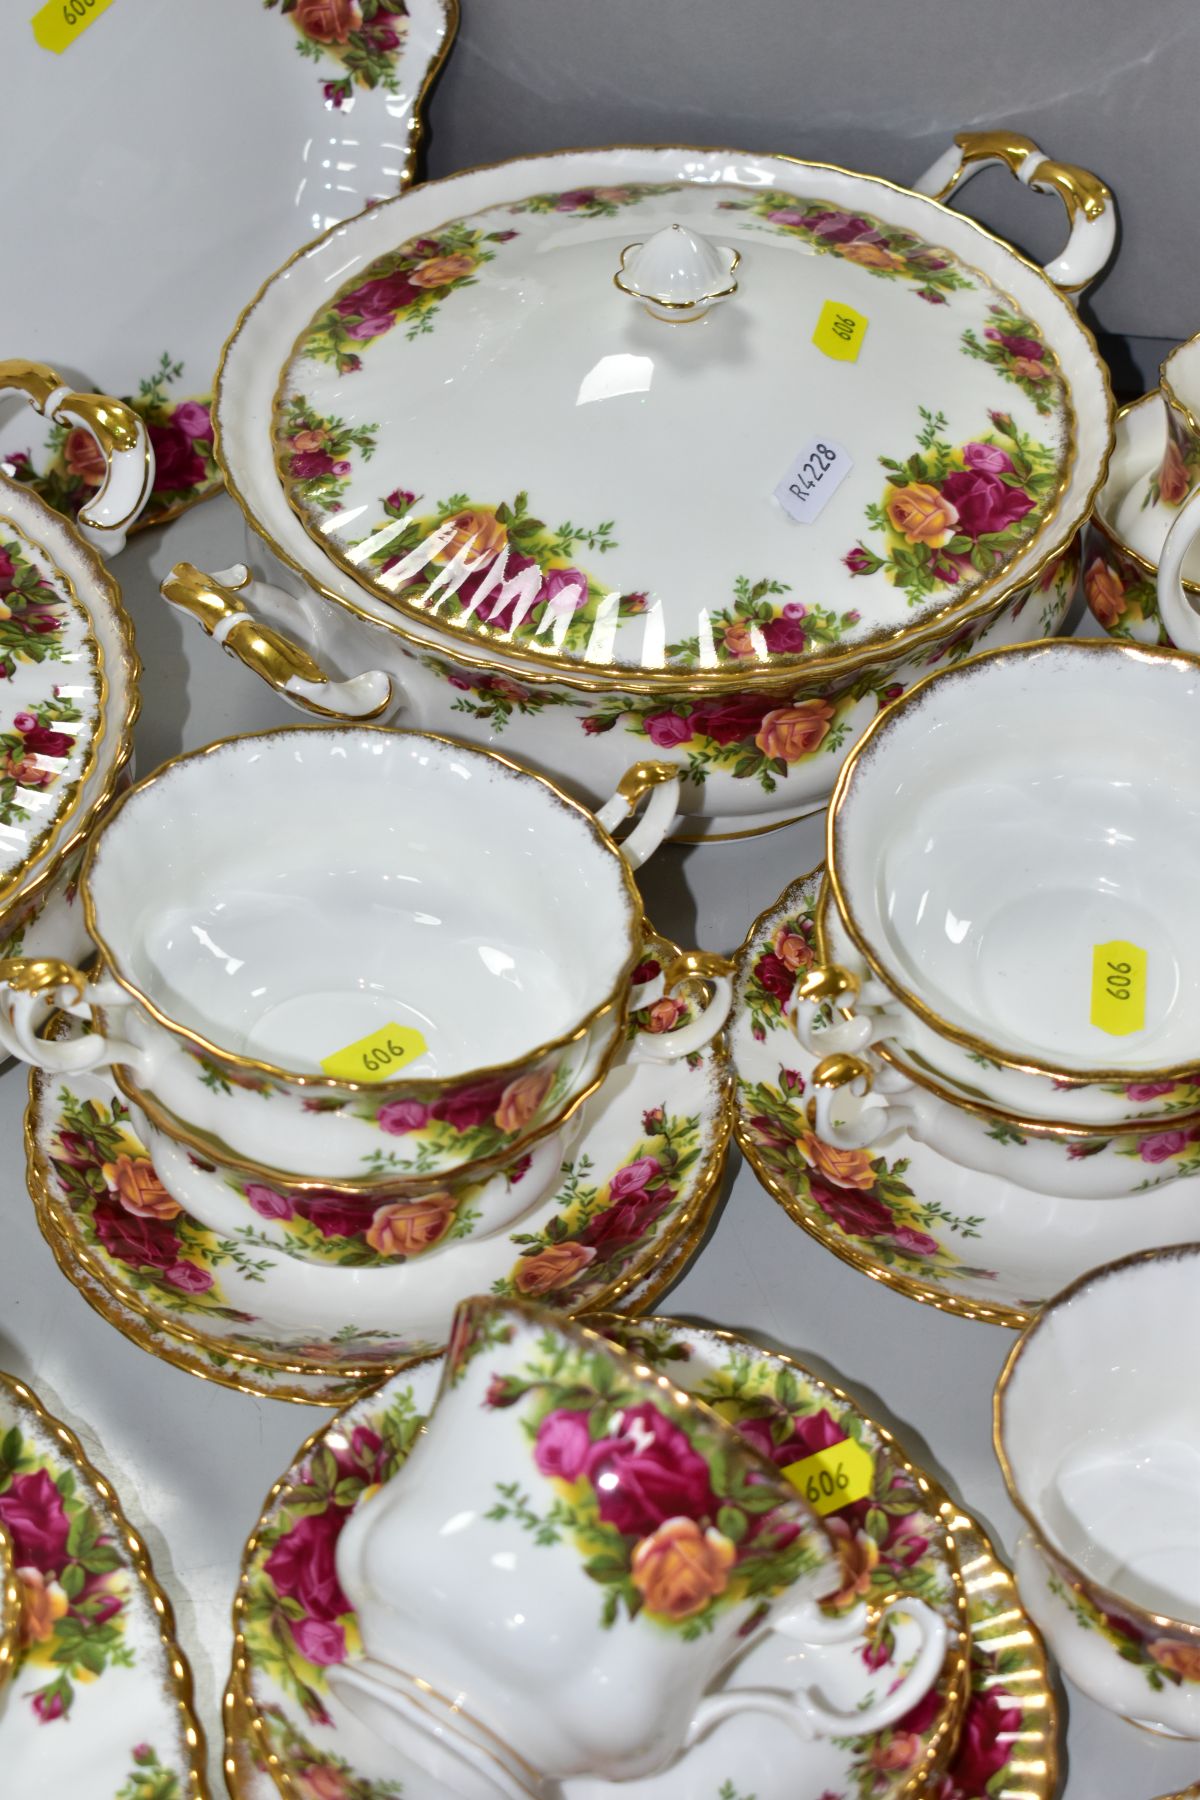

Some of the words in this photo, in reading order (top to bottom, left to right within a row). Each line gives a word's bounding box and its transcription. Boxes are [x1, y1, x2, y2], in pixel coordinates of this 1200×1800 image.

[831, 314, 857, 341] 606
[788, 443, 837, 502] R4228
[1105, 961, 1132, 1000] 606
[362, 1039, 405, 1072] 606
[805, 1461, 850, 1503] 606
